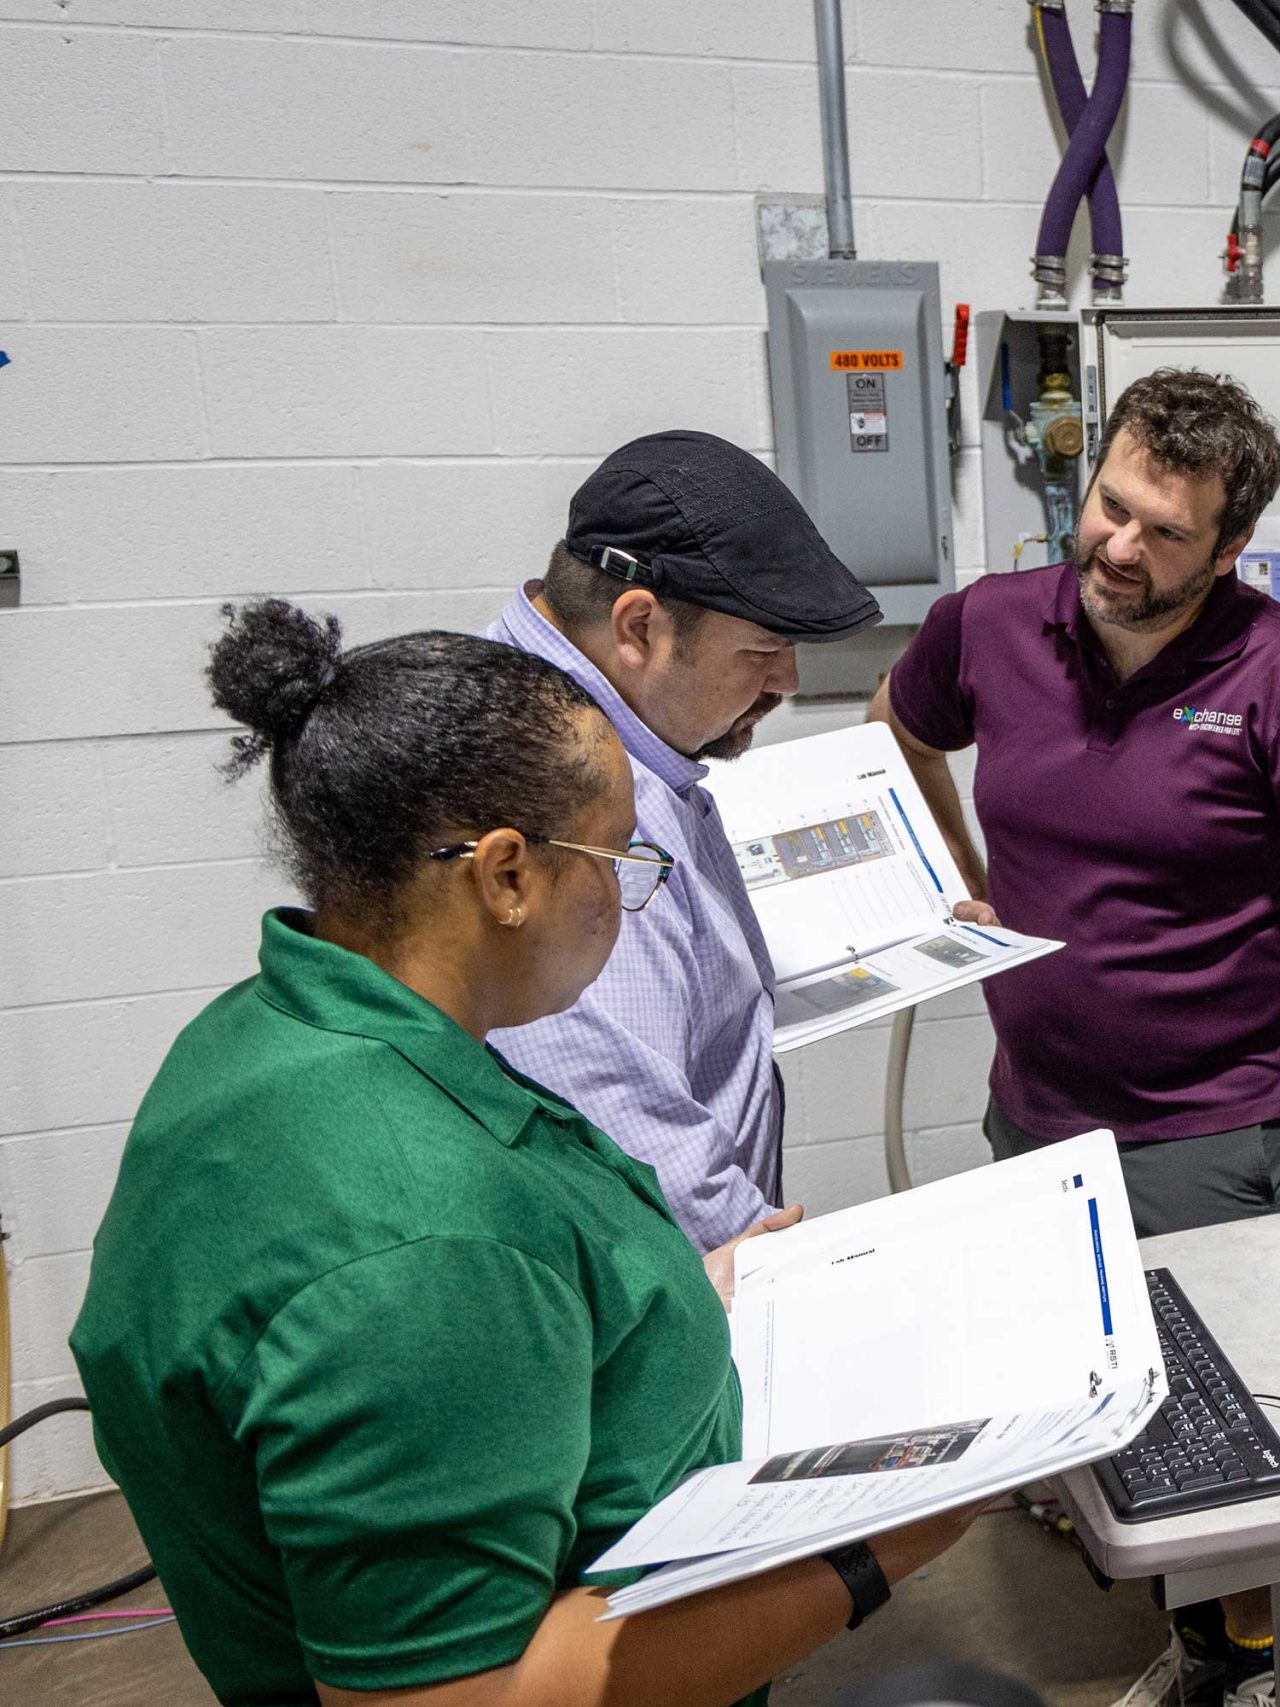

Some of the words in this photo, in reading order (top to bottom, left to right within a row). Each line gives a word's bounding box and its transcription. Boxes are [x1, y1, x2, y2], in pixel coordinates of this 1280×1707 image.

[792, 263, 918, 286] SIEMENS
[835, 354, 858, 367] 480
[862, 354, 899, 367] VOLTS
[855, 378, 876, 389] ON
[856, 435, 882, 446] OFF
[1109, 1350, 1118, 1369] RSTI
